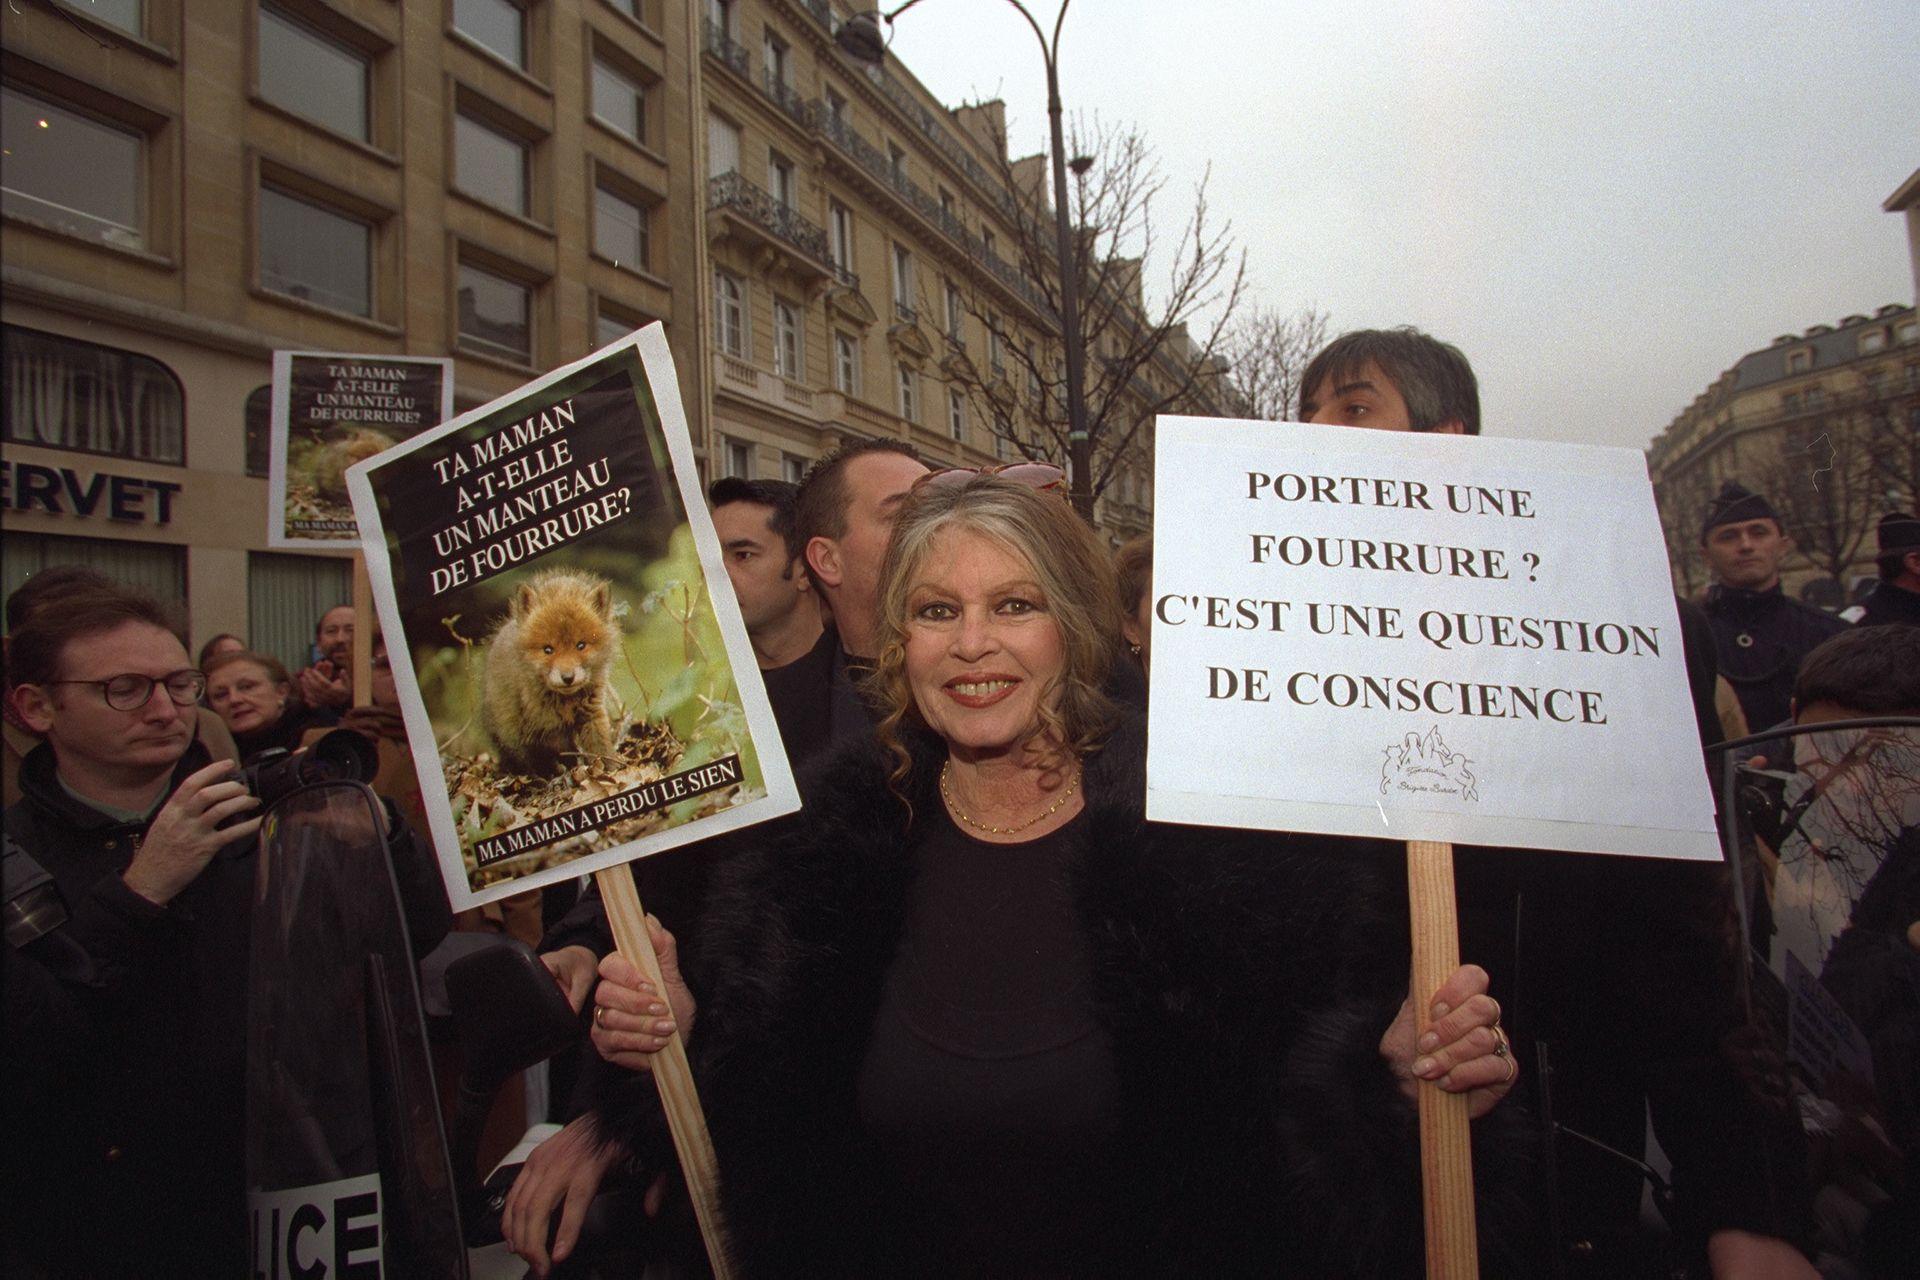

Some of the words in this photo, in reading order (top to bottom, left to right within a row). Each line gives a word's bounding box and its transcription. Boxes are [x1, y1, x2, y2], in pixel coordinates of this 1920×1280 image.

[316, 393, 340, 405] UN
[343, 394, 415, 408] MANTEAU
[329, 365, 347, 378] TA
[350, 366, 407, 380] MAMAN
[334, 381, 399, 394] A-T-ELLE
[310, 407, 332, 419] DE
[335, 410, 420, 424] FOURRURE?
[433, 454, 470, 485] TA
[472, 400, 576, 468] MAMAN
[456, 438, 574, 513] A-T-ELLE
[1247, 471, 1433, 511] PORTER
[1445, 484, 1536, 518] UNE
[432, 520, 472, 558] UN
[474, 458, 610, 540] MANTEAU
[430, 558, 470, 597] DE
[471, 488, 631, 578] FOURRURE?
[1249, 533, 1509, 580] FOURRURE
[1523, 552, 1540, 582] ?
[1155, 594, 1290, 632] C'EST
[1307, 603, 1404, 640] UNE
[1418, 610, 1661, 658] QUESTION
[1206, 666, 1270, 702] DE
[1286, 671, 1608, 725] CONSCIENCE
[478, 842, 508, 862] MA
[508, 817, 577, 852] MAMAN
[579, 812, 593, 828] A
[594, 788, 658, 823] PERDU
[664, 778, 687, 801] LE
[688, 761, 737, 792] SIEN
